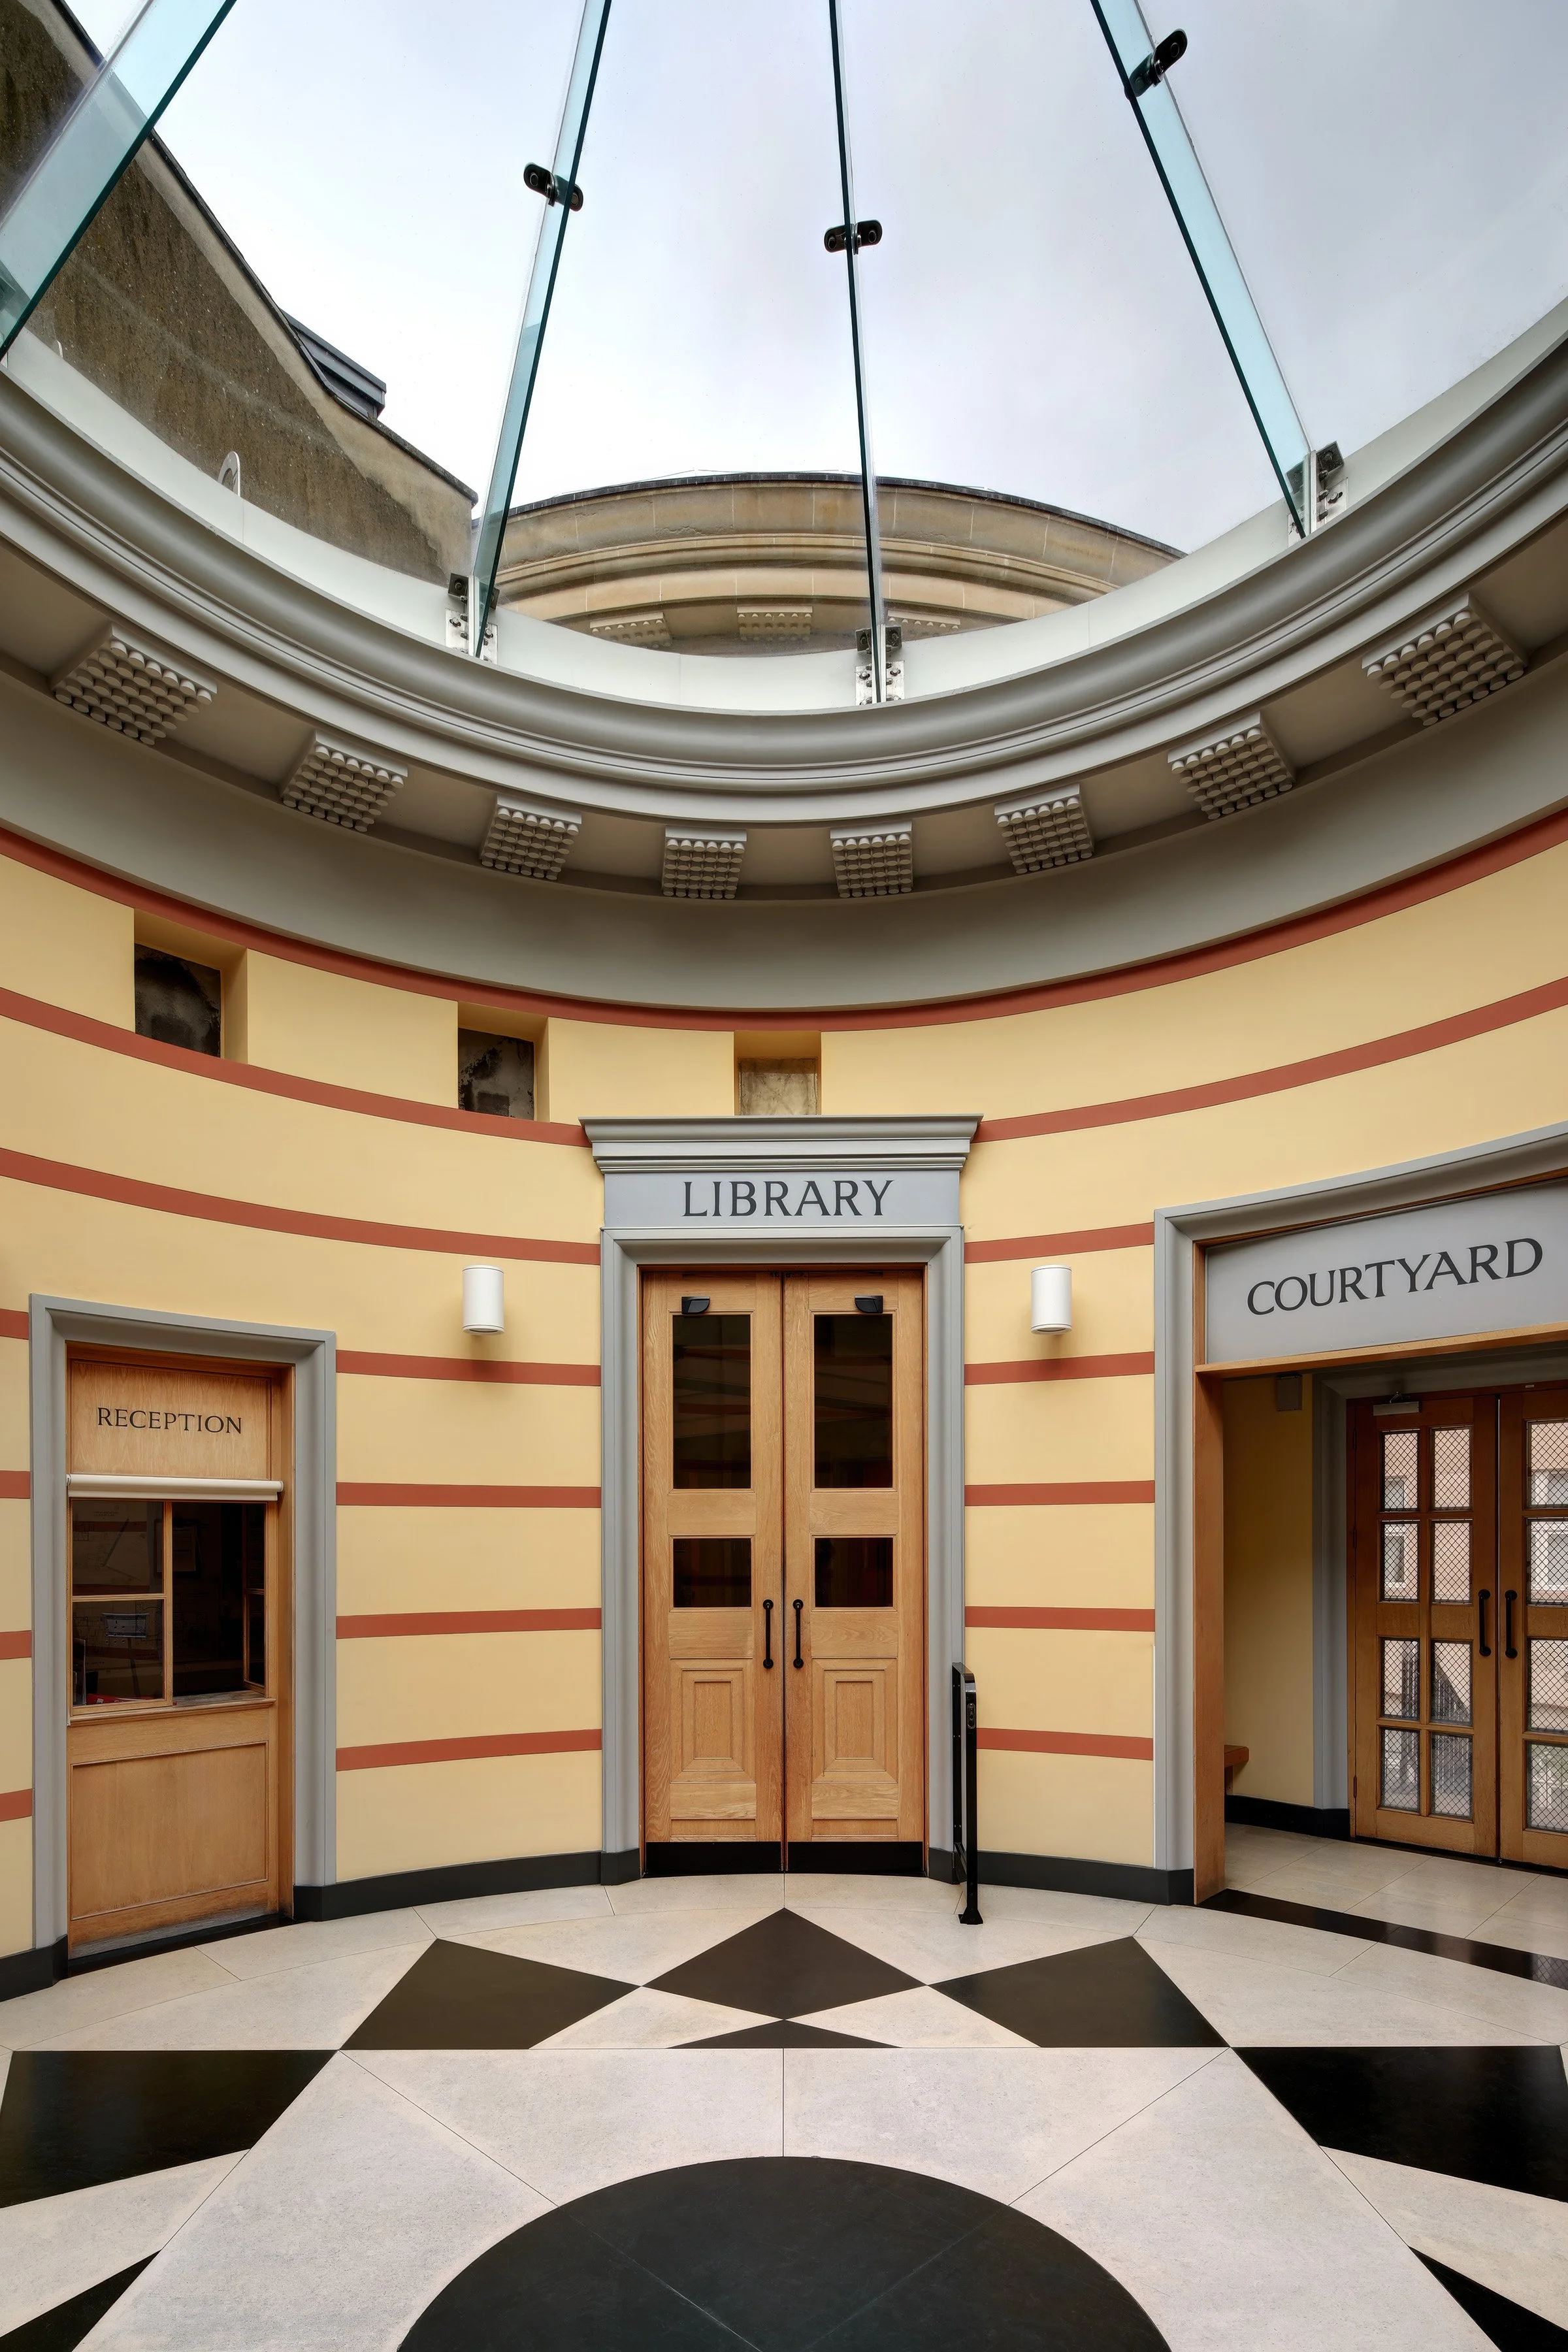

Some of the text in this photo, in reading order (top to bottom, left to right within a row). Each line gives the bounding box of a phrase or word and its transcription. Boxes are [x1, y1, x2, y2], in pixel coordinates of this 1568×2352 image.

[683, 1180, 893, 1217] LIBRARY
[1247, 1237, 1543, 1315] COURTYARD
[97, 1407, 242, 1434] RECEPTION
